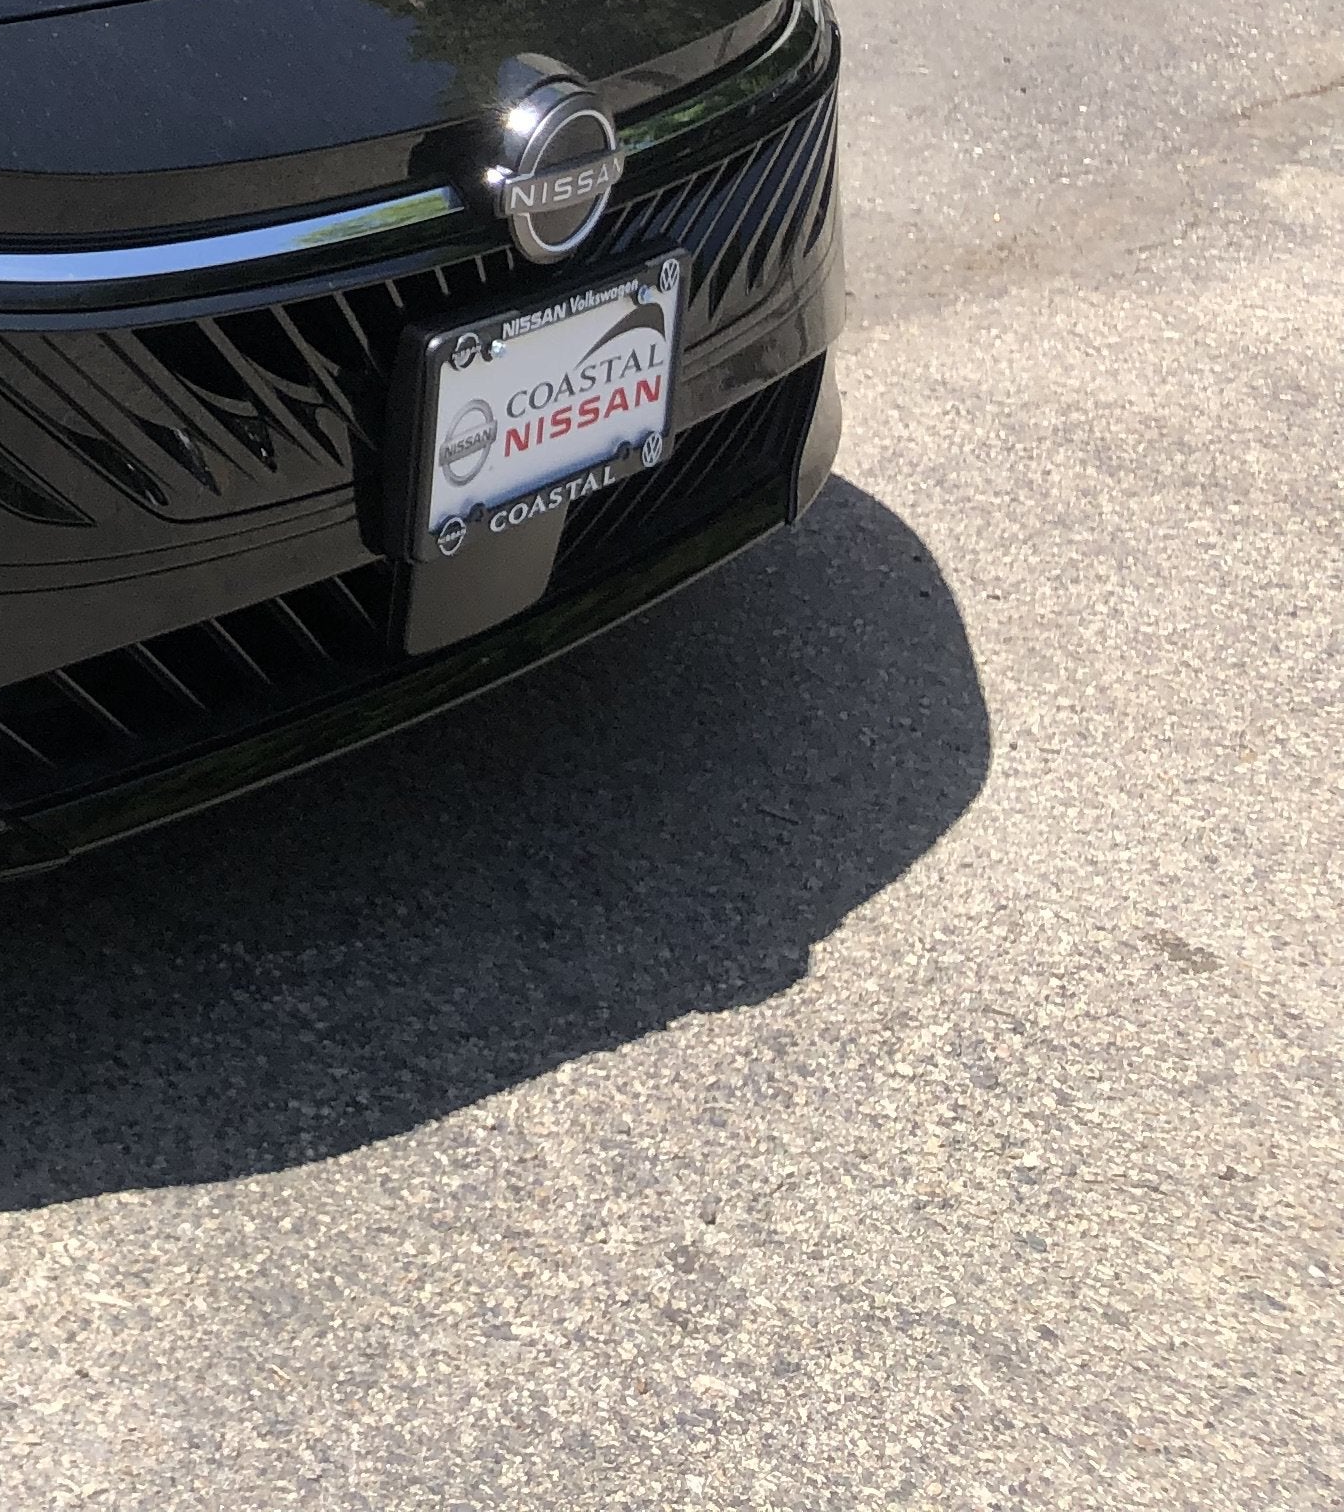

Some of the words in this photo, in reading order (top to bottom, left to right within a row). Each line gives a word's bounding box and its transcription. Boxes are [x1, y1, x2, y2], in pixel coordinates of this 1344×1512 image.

[511, 158, 621, 209] NISSAN
[502, 302, 566, 340] NISSAN
[569, 279, 639, 314] Volkswagen
[505, 342, 664, 419] COASTAL
[443, 426, 493, 459] NISSAN
[503, 374, 662, 458] NISSAN
[489, 466, 616, 533] COASTAL
